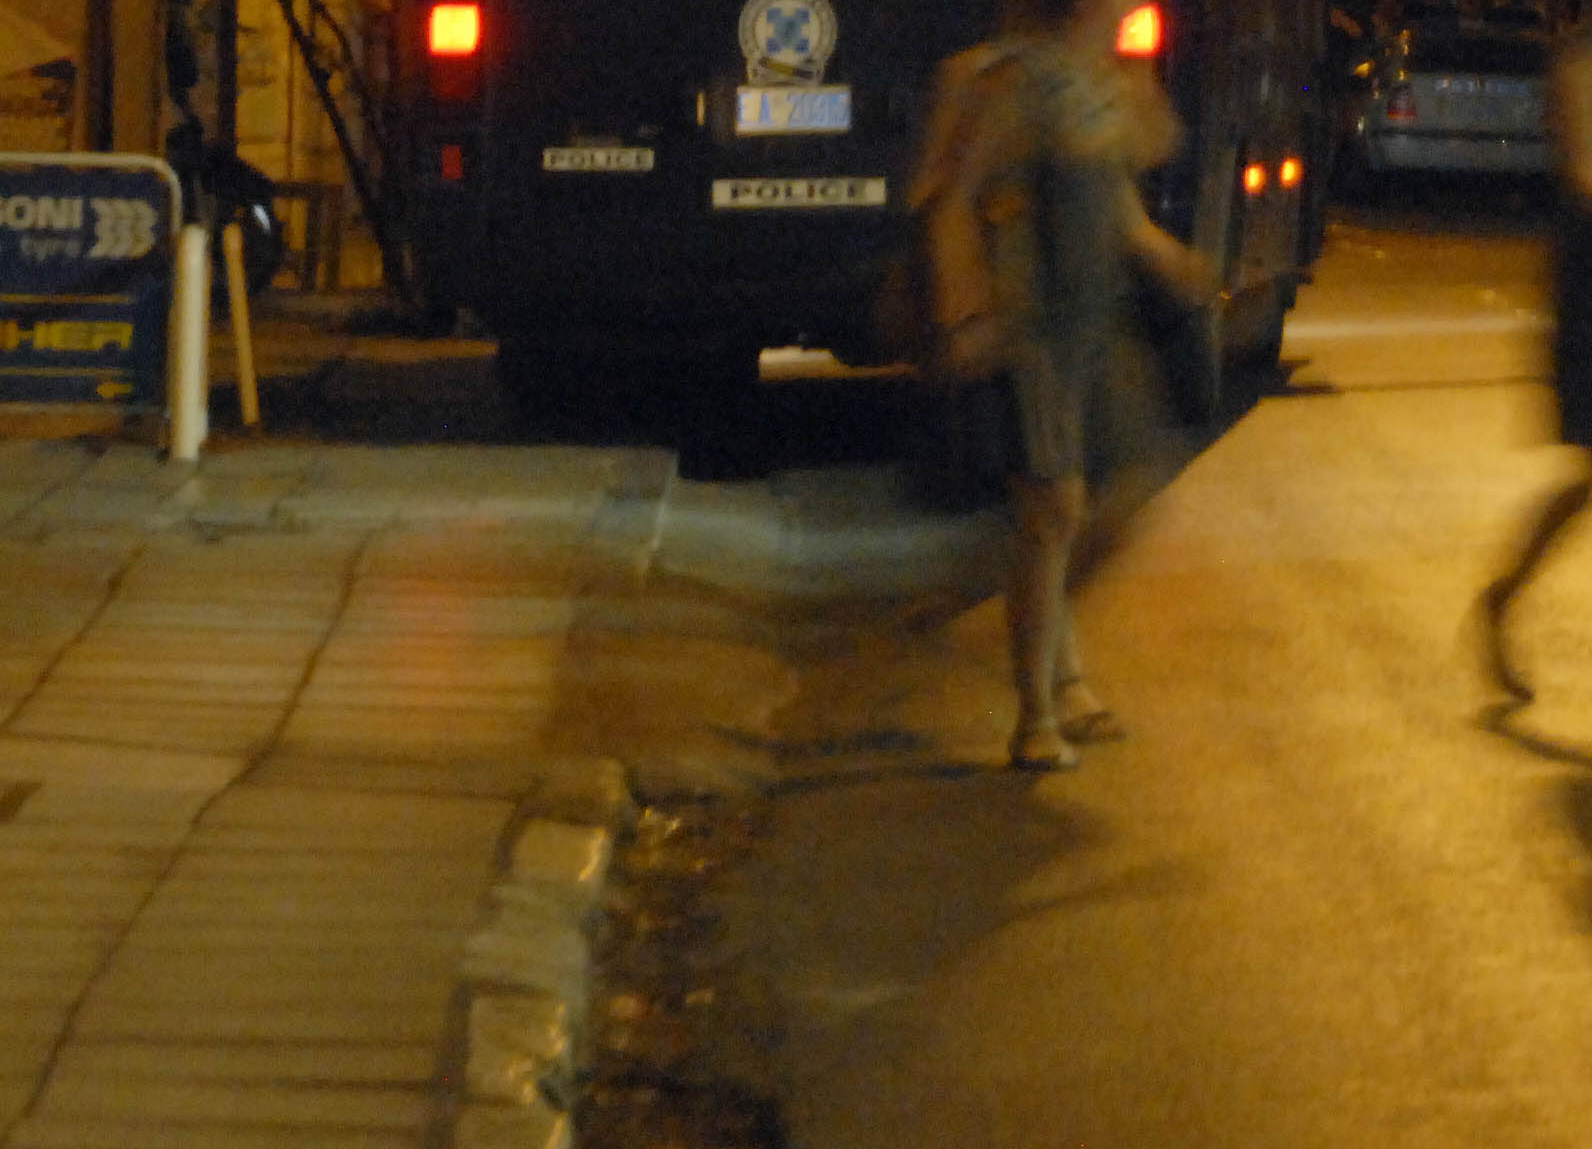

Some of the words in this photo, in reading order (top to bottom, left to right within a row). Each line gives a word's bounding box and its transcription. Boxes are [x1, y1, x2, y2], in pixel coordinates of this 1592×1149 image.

[549, 152, 648, 168] POLICE
[729, 184, 865, 202] POLICE
[0, 195, 84, 230] ONI
